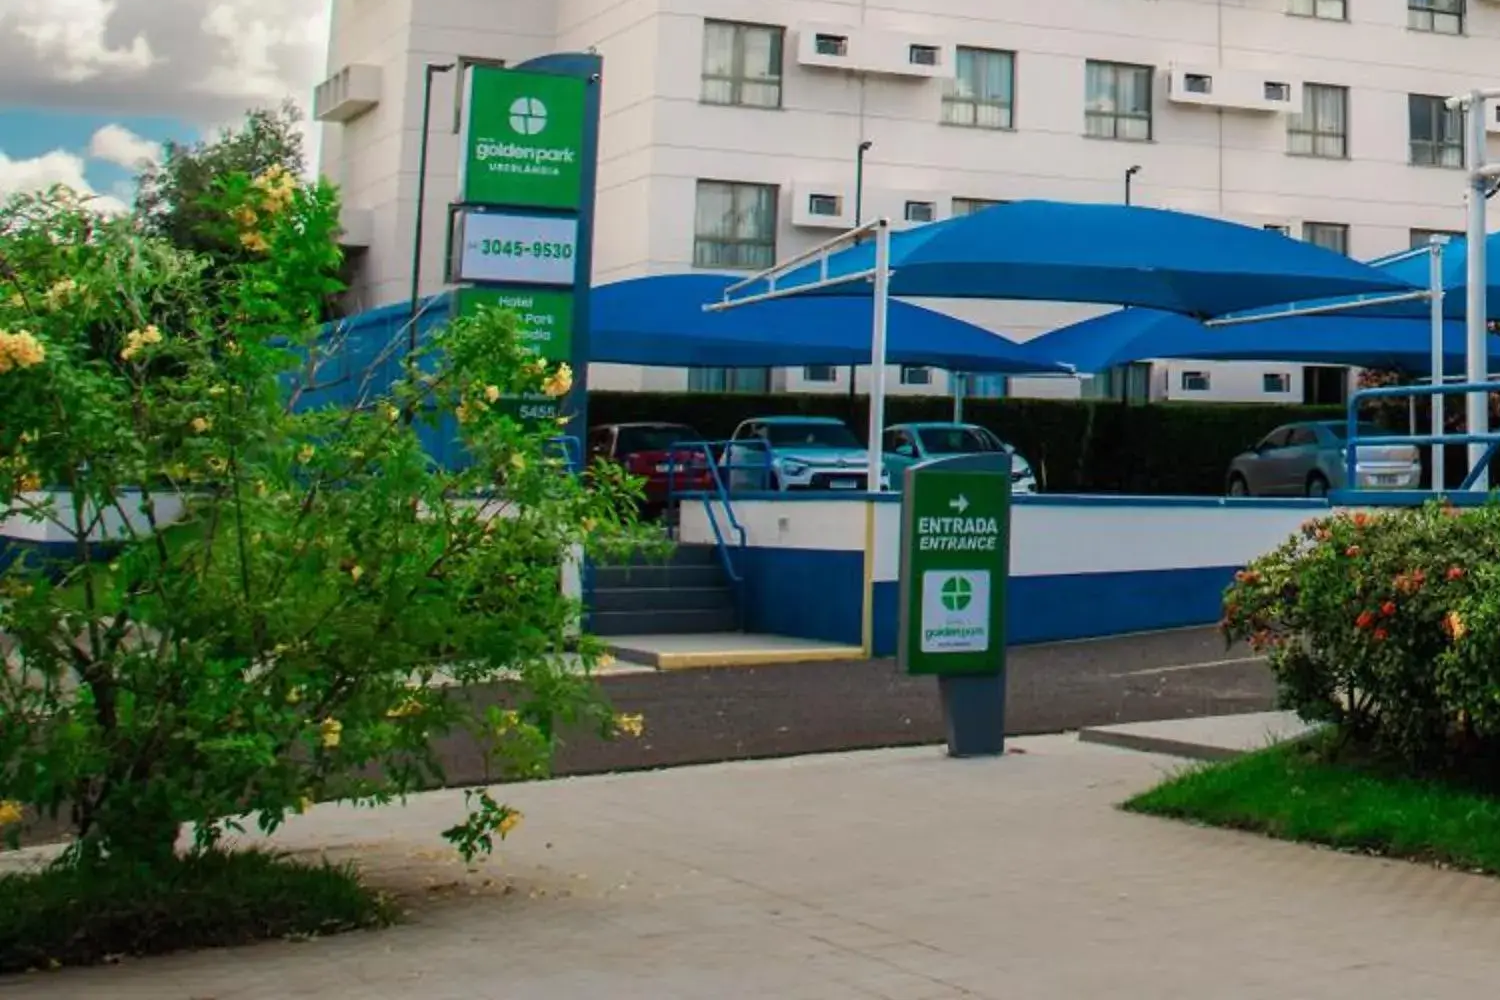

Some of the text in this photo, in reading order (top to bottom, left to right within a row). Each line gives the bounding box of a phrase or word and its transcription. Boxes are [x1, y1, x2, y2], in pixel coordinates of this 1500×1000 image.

[476, 142, 575, 164] goldenpark
[481, 239, 572, 258] 3045-9530
[498, 295, 534, 308] Hotel
[525, 313, 554, 325] Park
[918, 517, 998, 533] ENTRADA
[919, 536, 996, 550] ENTRANCE
